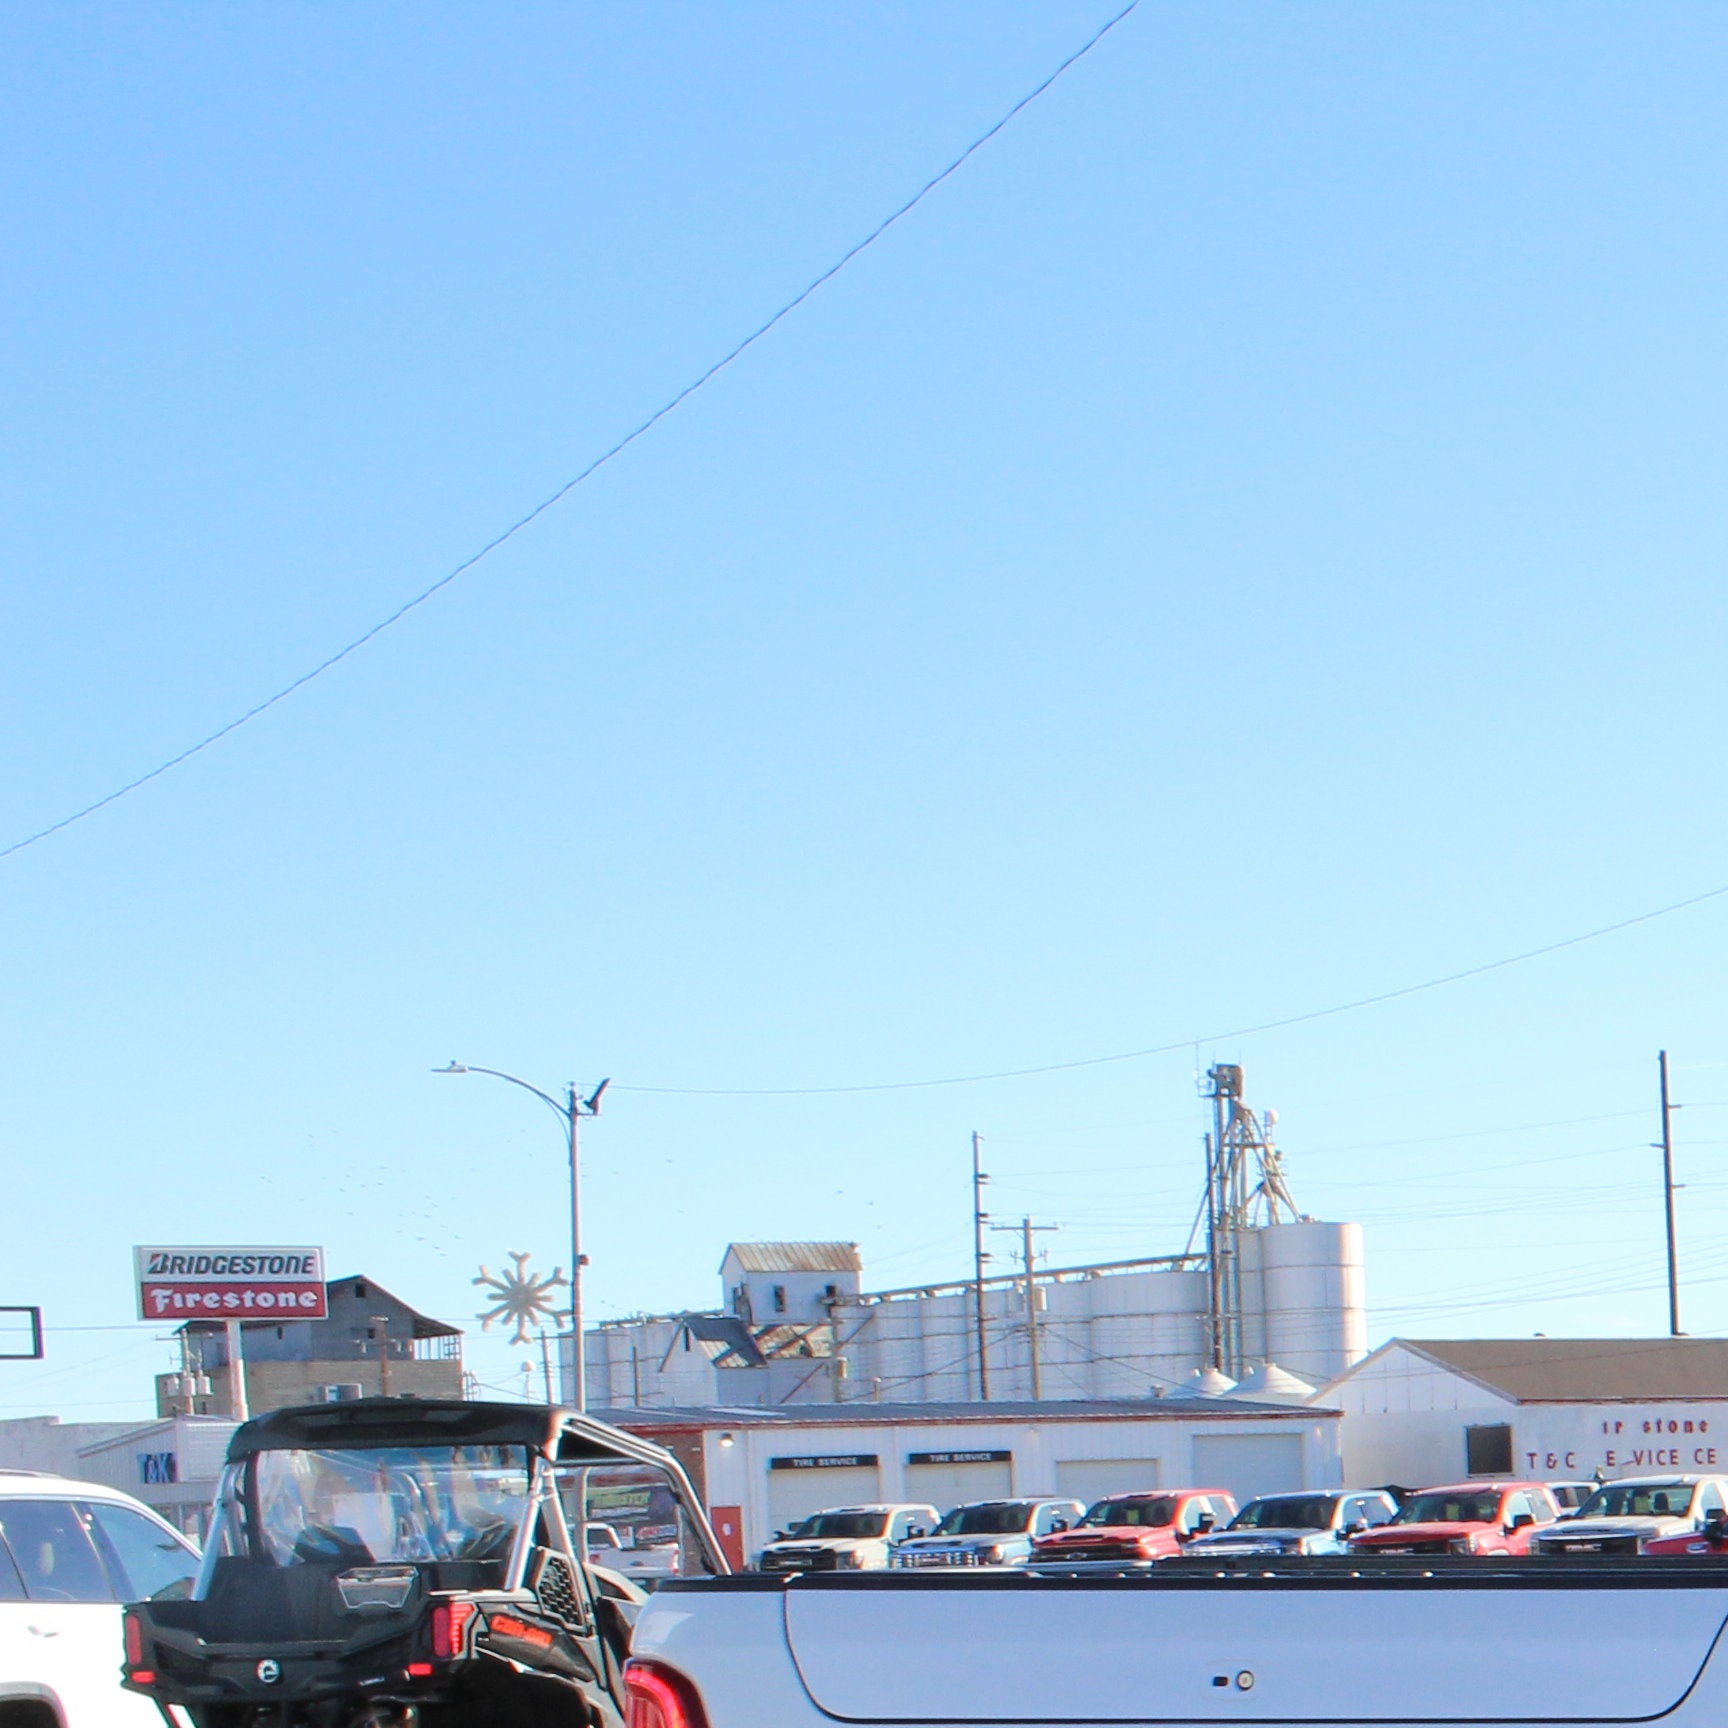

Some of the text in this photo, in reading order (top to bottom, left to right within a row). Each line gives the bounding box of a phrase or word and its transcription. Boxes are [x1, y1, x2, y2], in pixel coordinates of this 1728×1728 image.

[147, 1253, 315, 1275] BRIDGESTONE
[151, 1288, 317, 1313] Firestone
[793, 1457, 857, 1467] TIRE SERVICE
[930, 1452, 992, 1462] TIRE SERVICE
